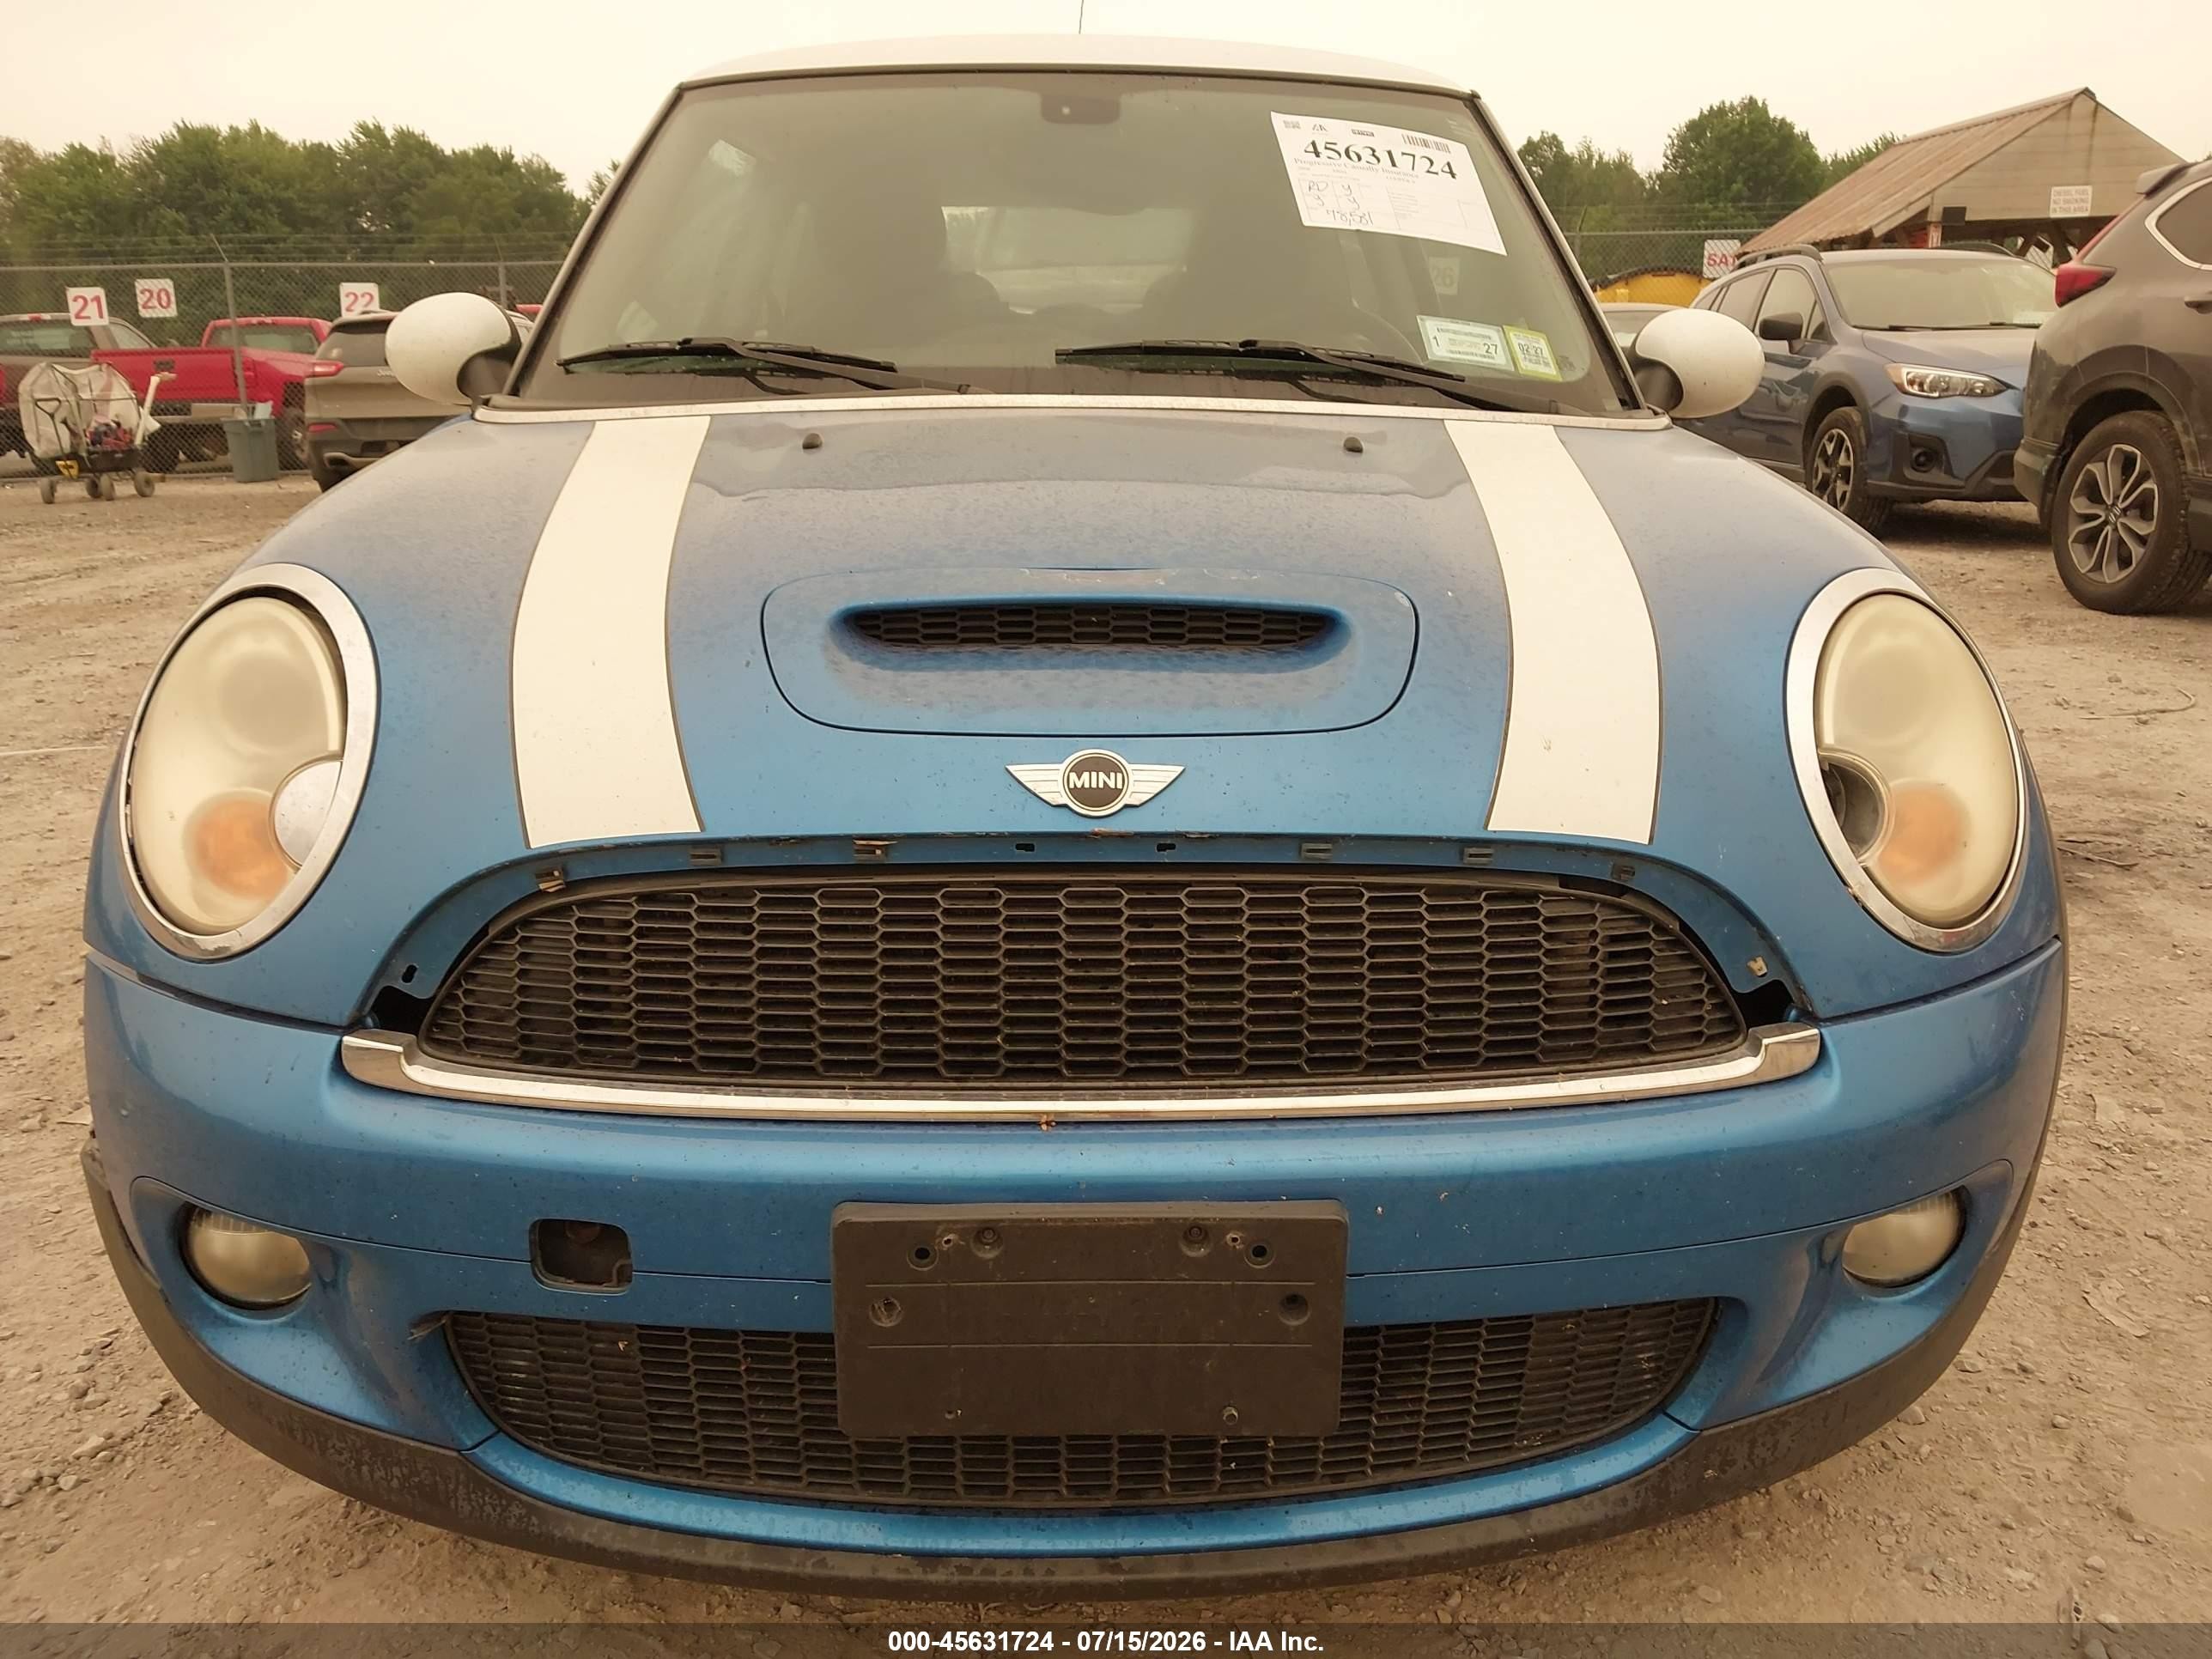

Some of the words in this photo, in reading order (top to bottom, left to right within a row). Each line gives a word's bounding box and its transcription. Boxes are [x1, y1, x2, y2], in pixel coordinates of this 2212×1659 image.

[1304, 139, 1458, 179] 45631724
[71, 295, 105, 319] 21
[140, 288, 172, 310] 20
[344, 291, 374, 313] 22
[1483, 343, 1498, 356] 27
[1068, 771, 1123, 790] MINI
